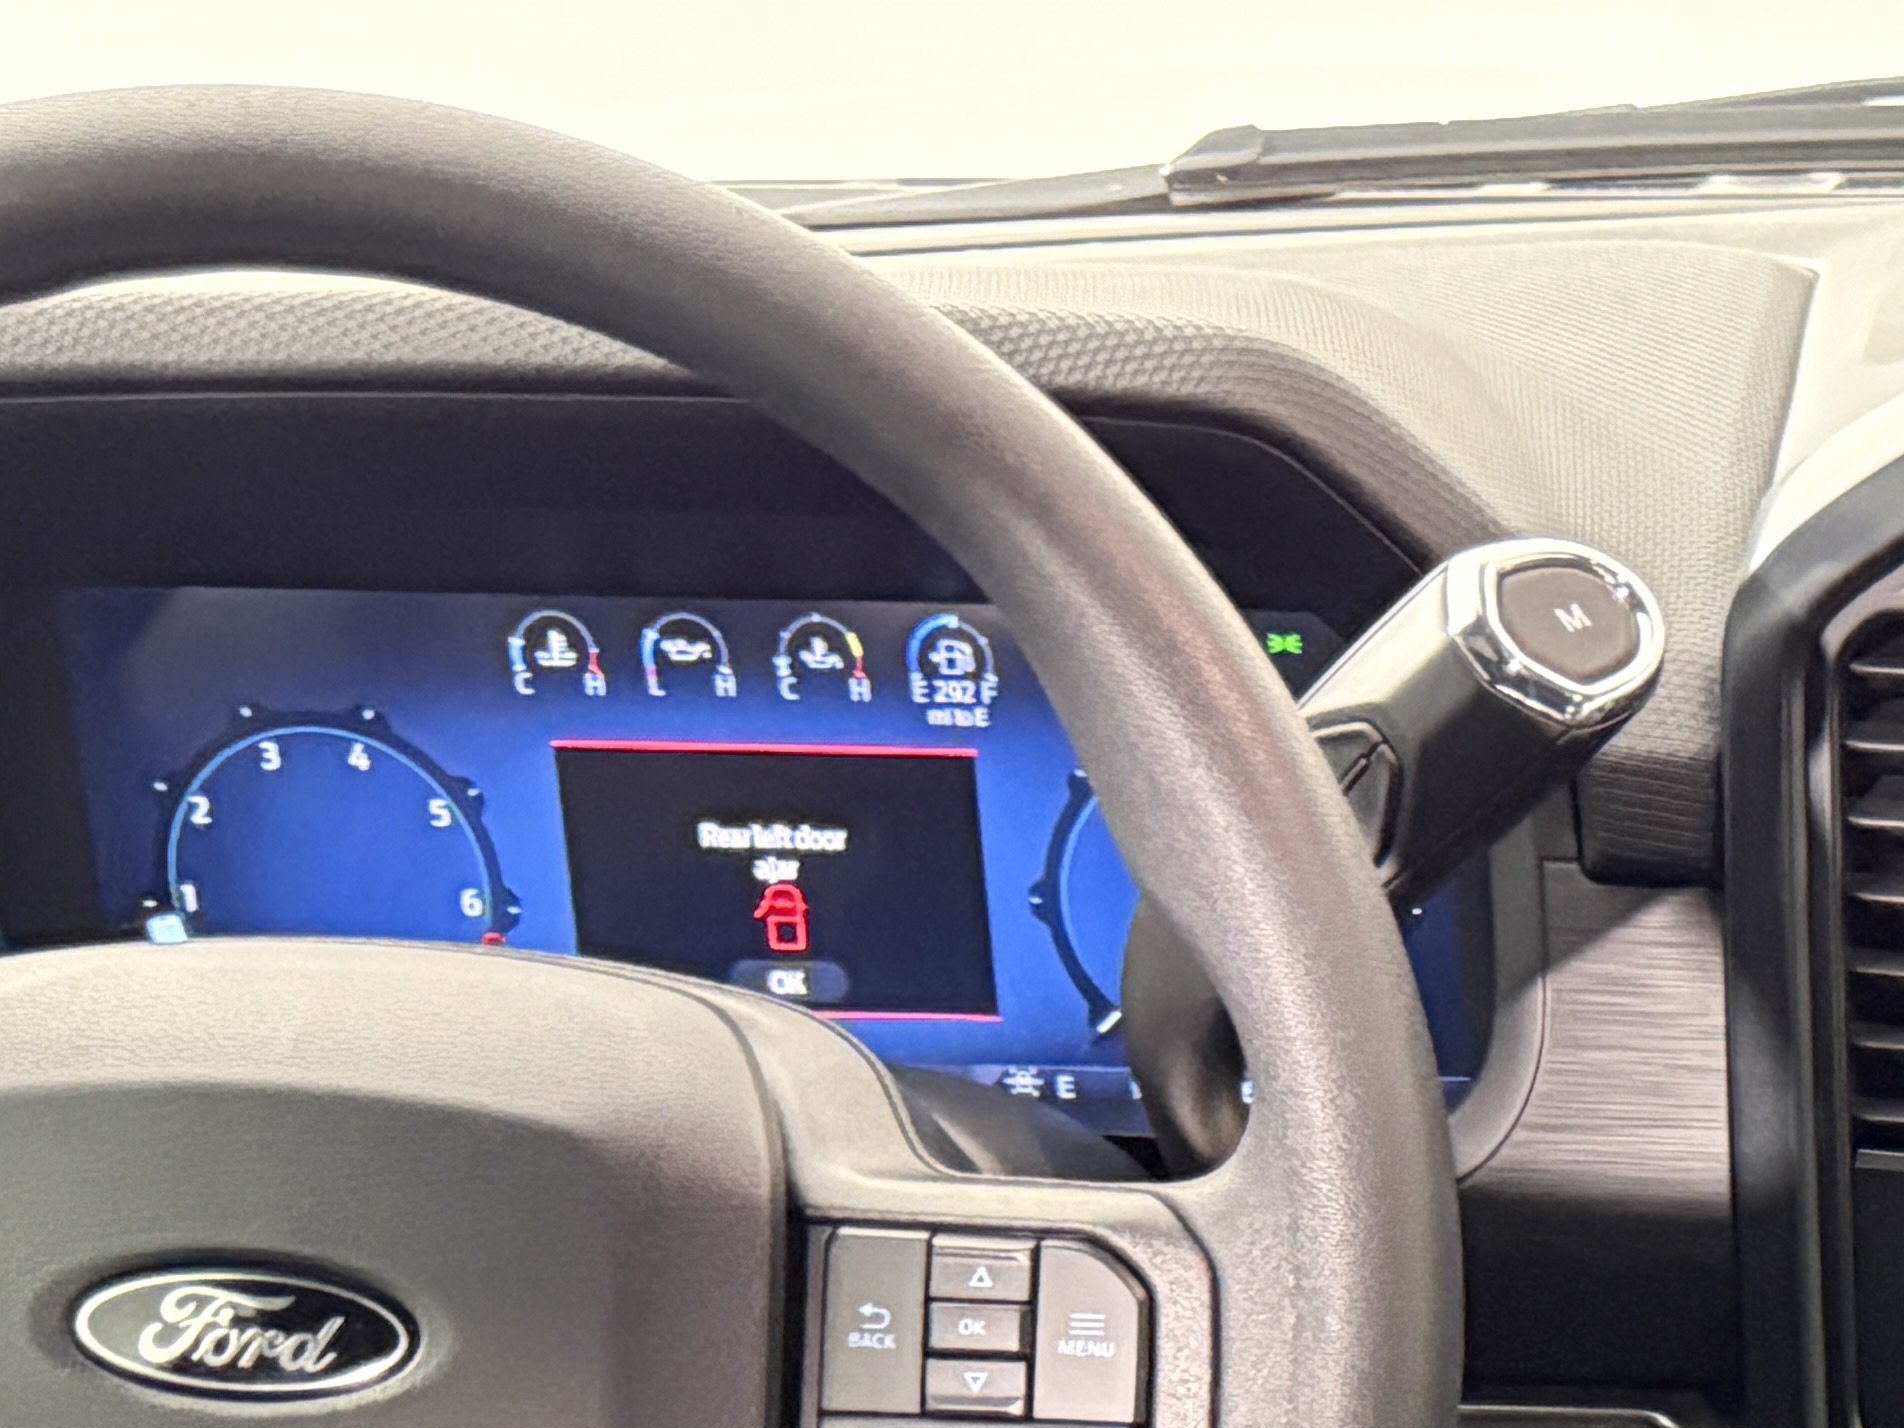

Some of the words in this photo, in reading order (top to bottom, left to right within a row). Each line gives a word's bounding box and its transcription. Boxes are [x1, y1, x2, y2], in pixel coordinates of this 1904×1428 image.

[1553, 603, 1592, 633] M
[513, 674, 535, 696] C
[584, 672, 606, 697] H
[932, 680, 977, 704] 292
[258, 741, 282, 771] 3
[348, 742, 371, 772] 4
[189, 795, 213, 825] 2
[428, 798, 452, 827] 5
[697, 821, 750, 848] Rear
[750, 823, 794, 849] left
[795, 824, 848, 851] door
[752, 856, 800, 883] ajar
[179, 883, 198, 912] 1
[460, 888, 484, 917] 6
[767, 969, 808, 995] OK
[138, 1286, 345, 1373] Ford
[848, 1332, 896, 1350] BACK
[958, 1318, 987, 1336] OK
[1058, 1340, 1115, 1358] MENU
